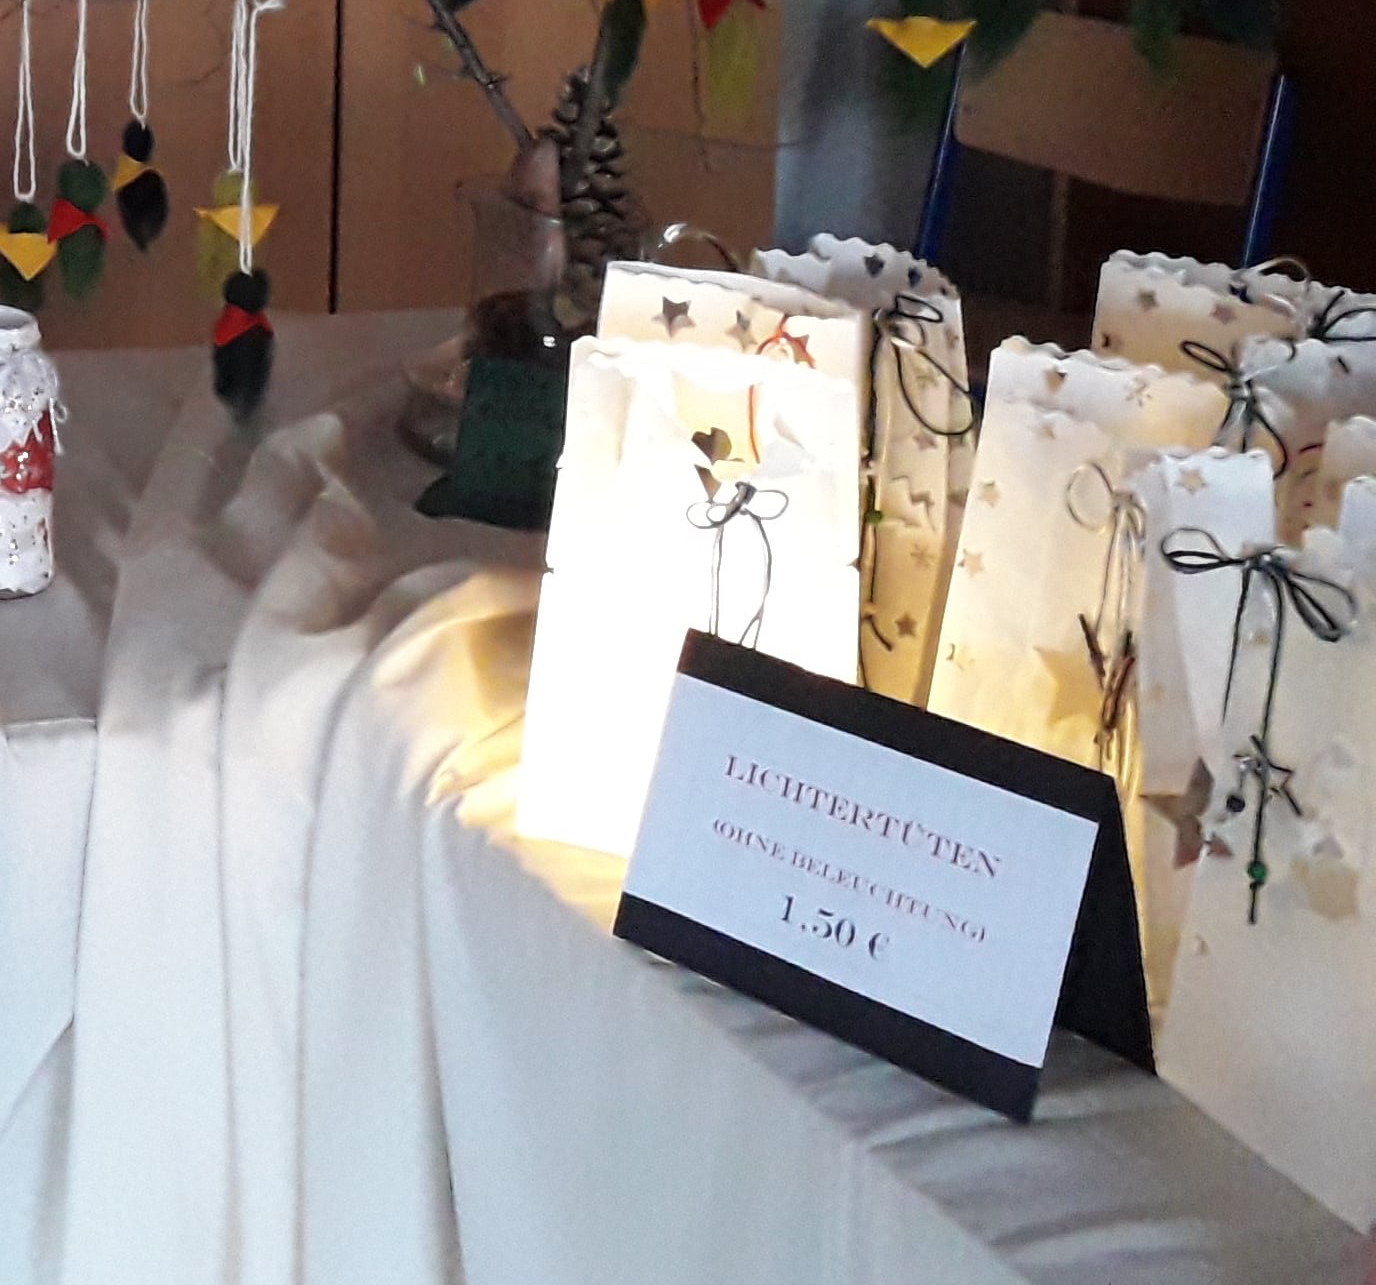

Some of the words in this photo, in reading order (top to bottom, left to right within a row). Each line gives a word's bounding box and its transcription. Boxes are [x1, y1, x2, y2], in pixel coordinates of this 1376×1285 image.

[724, 754, 1001, 877] LICHTERTÜTEN
[713, 818, 785, 861] (OHNE
[791, 850, 986, 943] BELEUCHTUNG)
[868, 931, 890, 961] €
